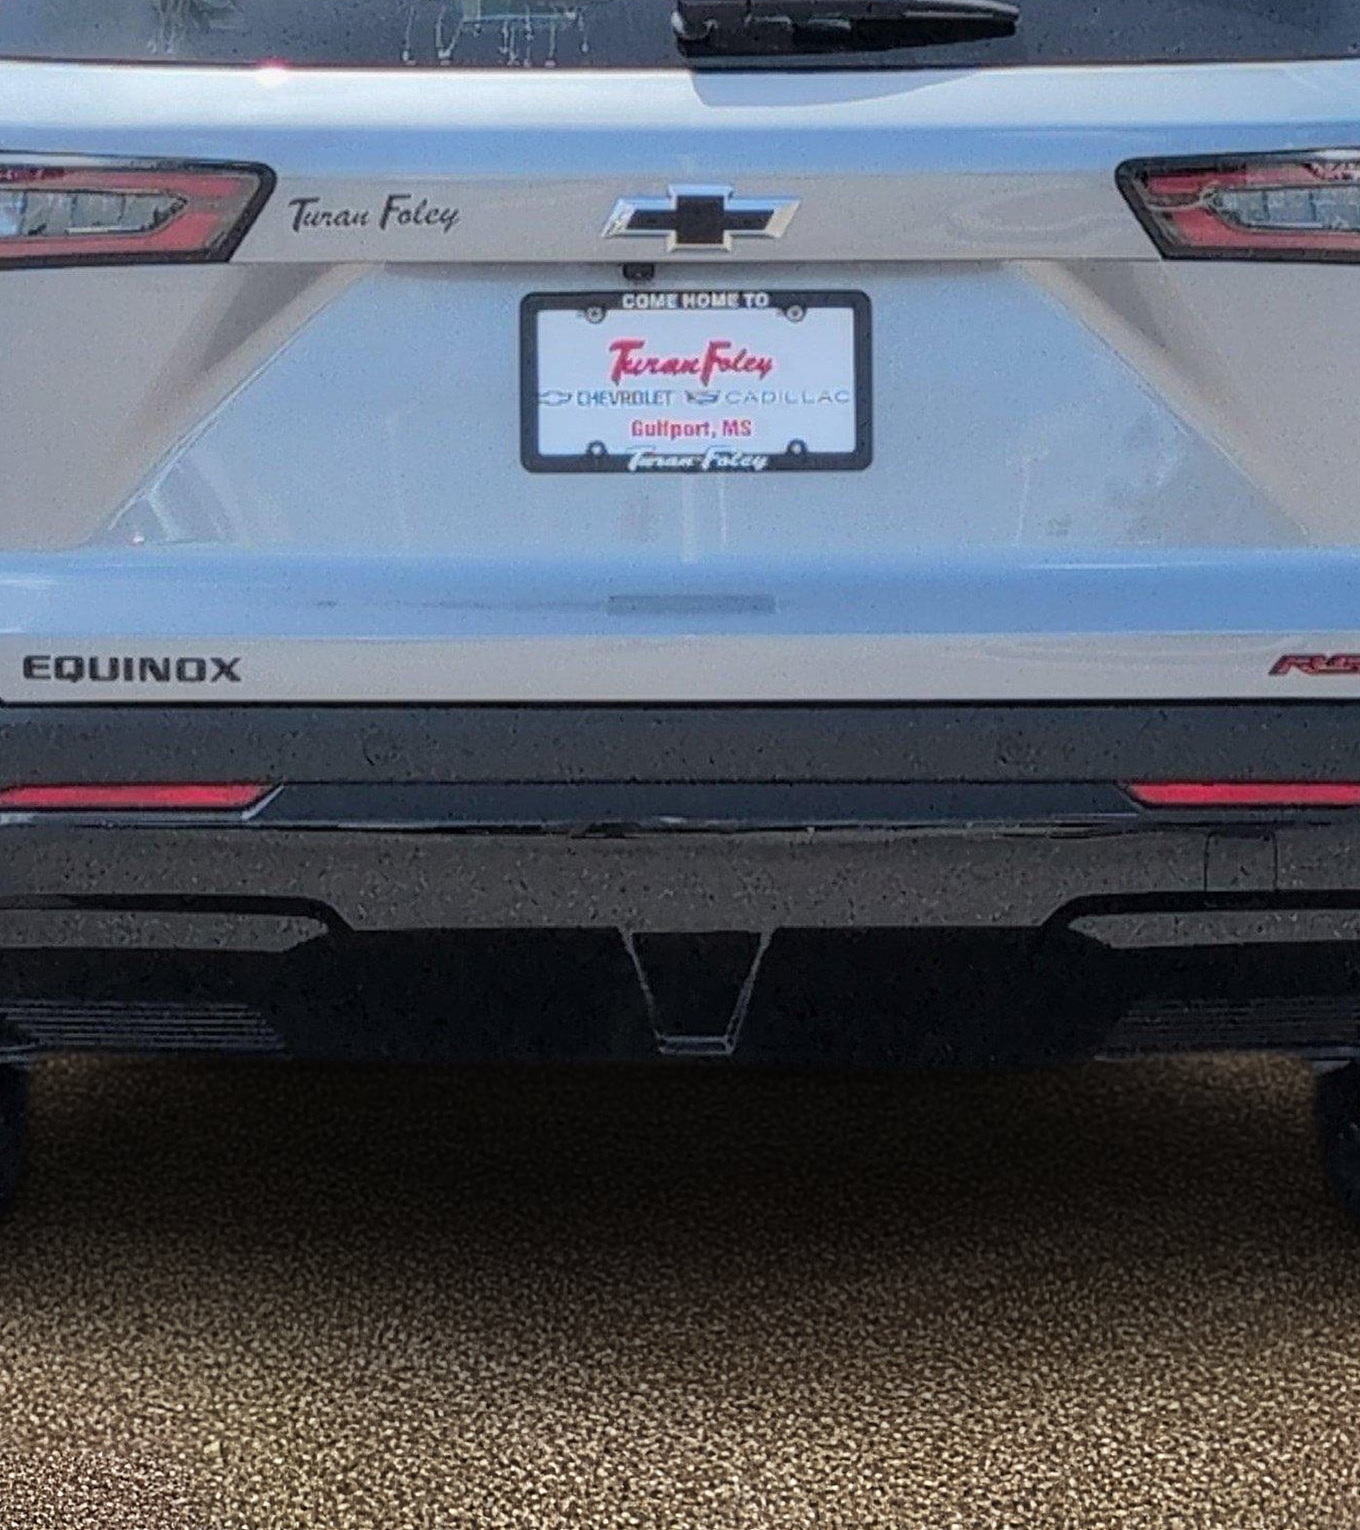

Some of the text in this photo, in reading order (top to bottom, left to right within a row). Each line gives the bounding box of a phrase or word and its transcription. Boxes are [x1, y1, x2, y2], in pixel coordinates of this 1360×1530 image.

[289, 193, 460, 234] Turan Foley
[622, 291, 769, 309] COME HOME TO
[576, 389, 850, 406] CHEVROLET CADILLAC
[631, 419, 752, 440] Gulfport, MS
[23, 654, 242, 682] EQUINOX
